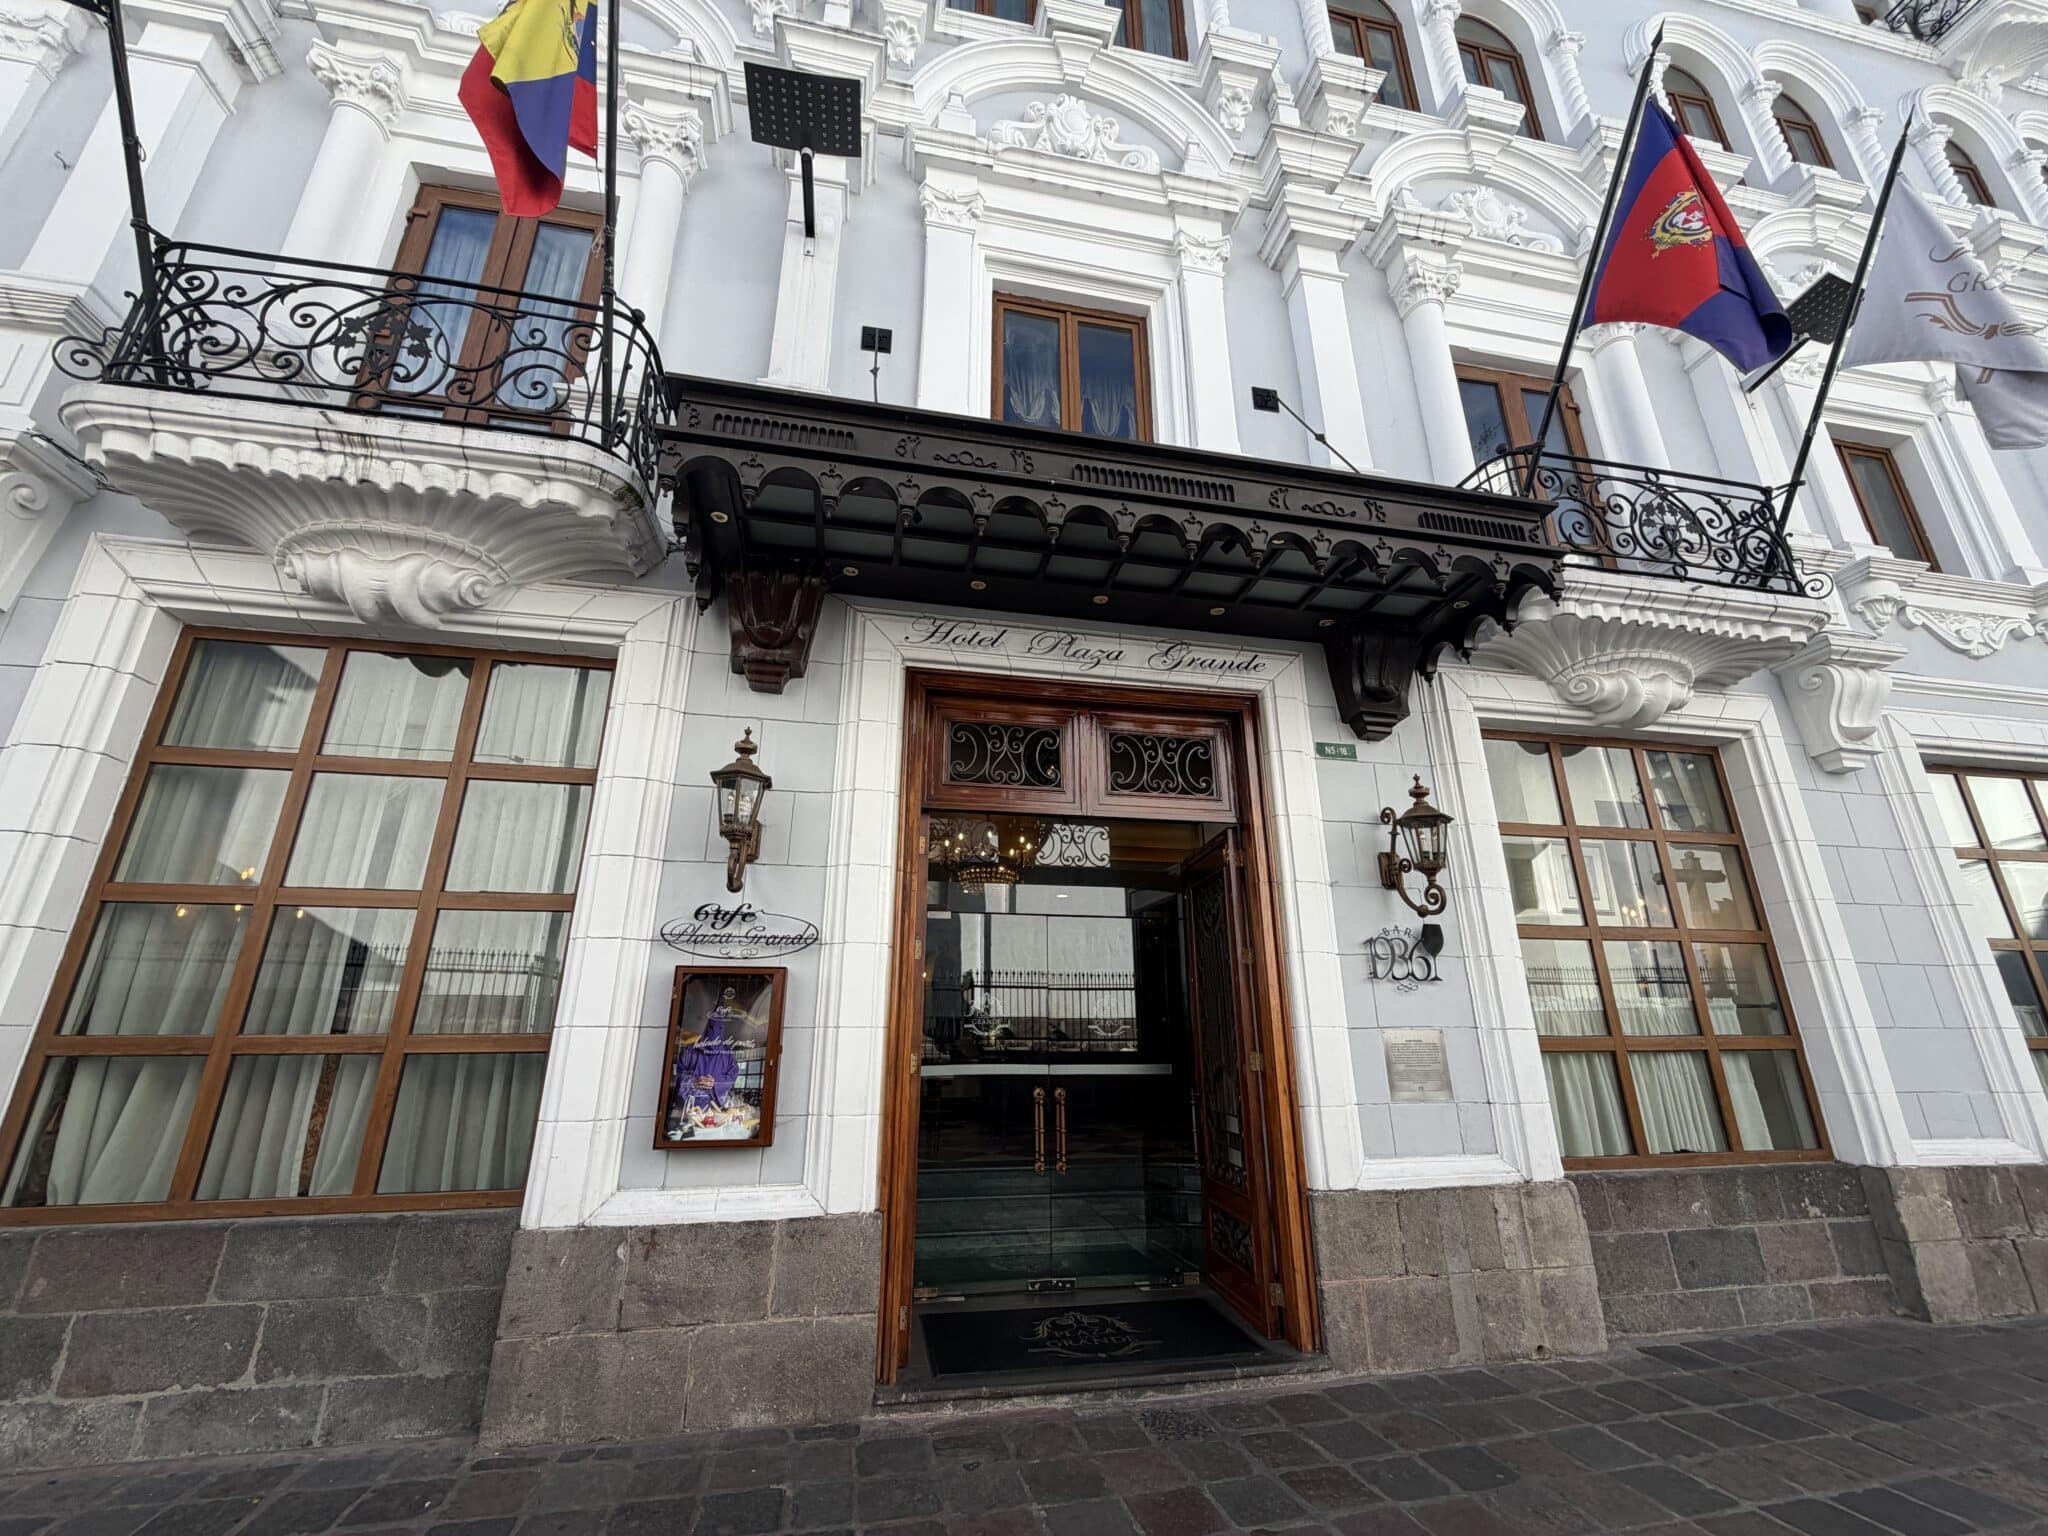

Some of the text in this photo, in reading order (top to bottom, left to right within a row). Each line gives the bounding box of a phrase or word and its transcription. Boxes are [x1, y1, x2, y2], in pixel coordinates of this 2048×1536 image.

[904, 616, 1266, 672] Hotel Plaza Grande
[669, 922, 815, 946] Plaza Grande
[1382, 925, 1412, 938] BAR
[1363, 936, 1431, 981] 1936
